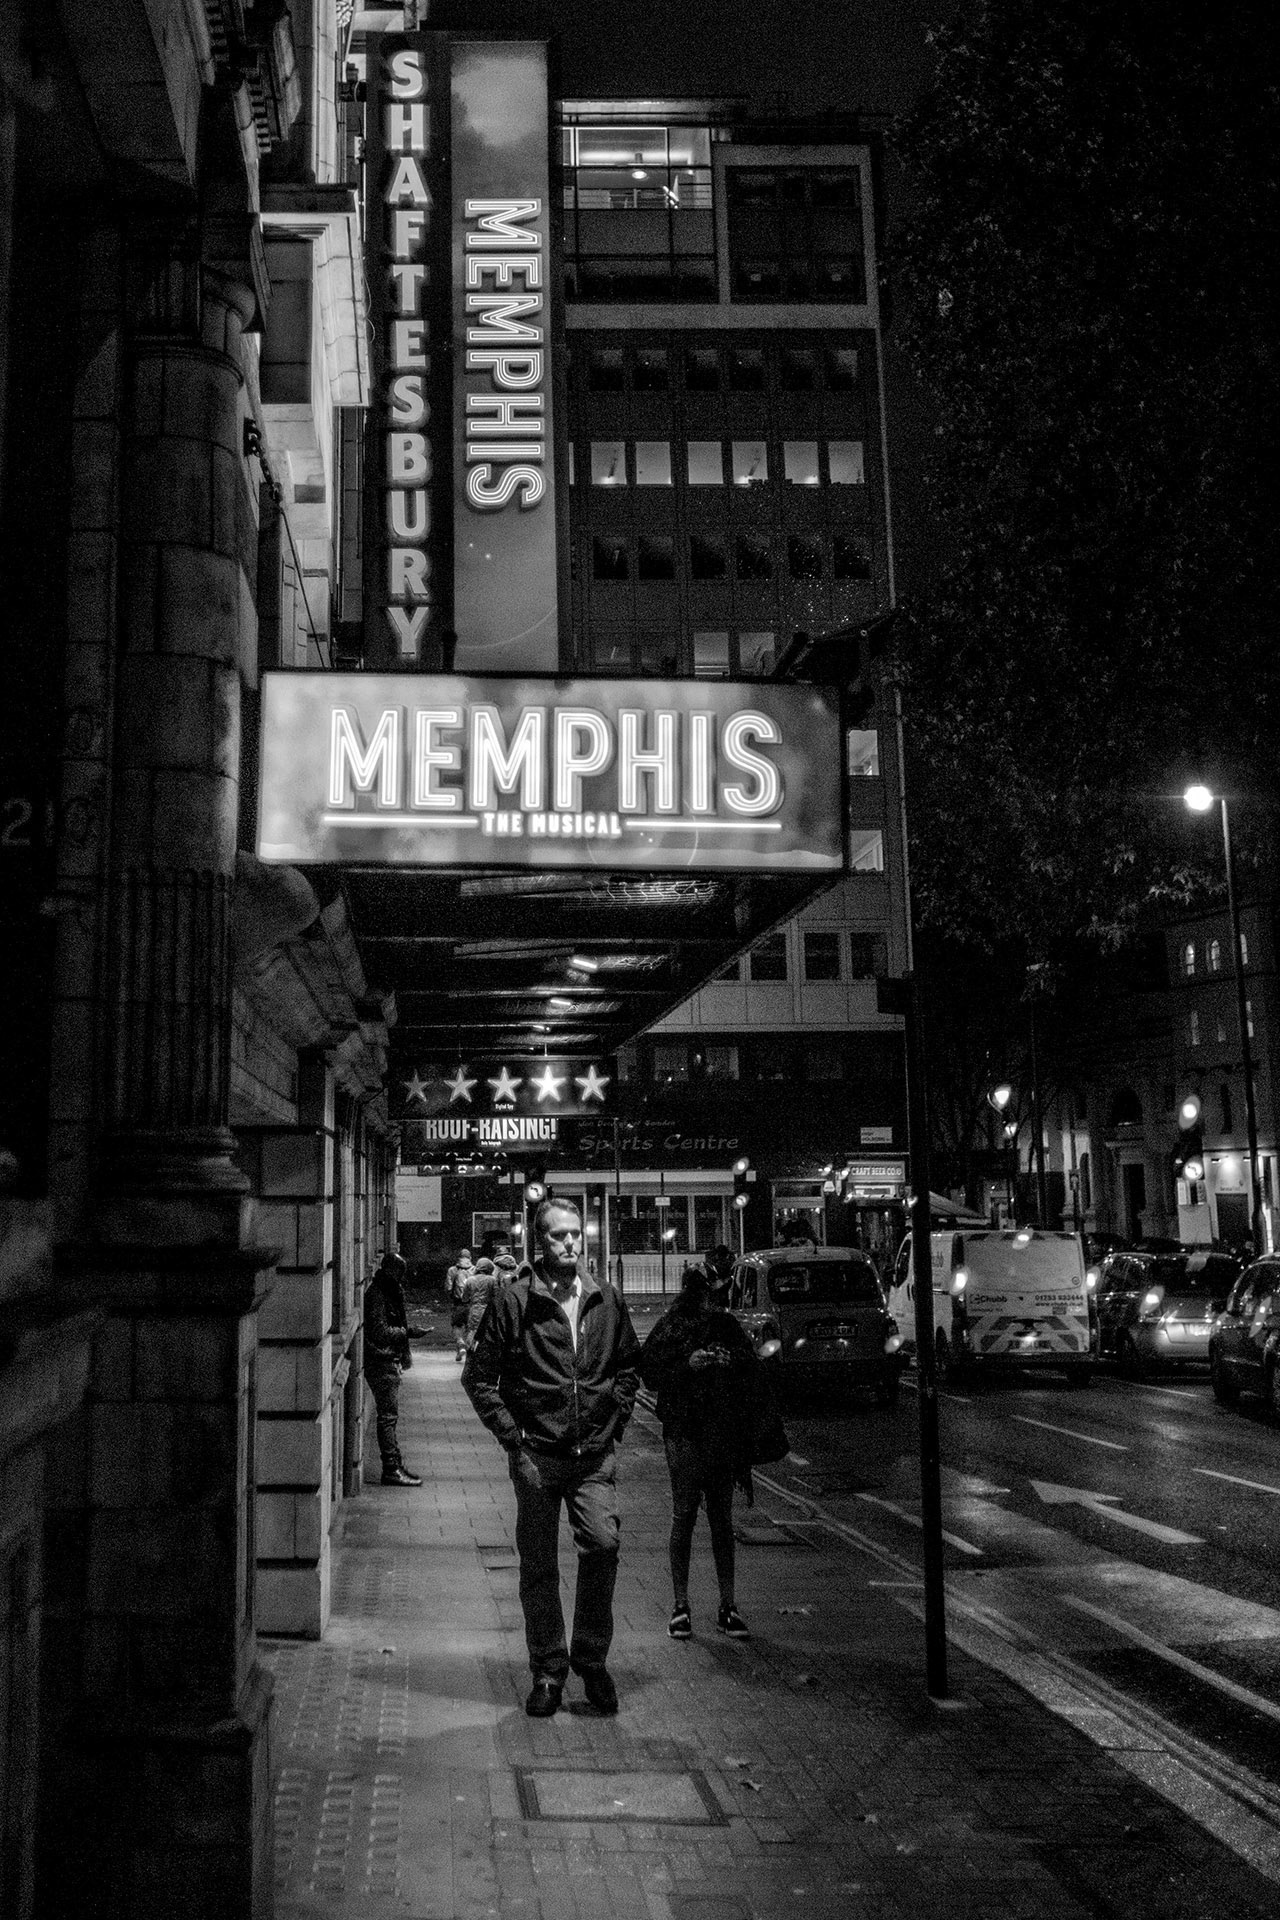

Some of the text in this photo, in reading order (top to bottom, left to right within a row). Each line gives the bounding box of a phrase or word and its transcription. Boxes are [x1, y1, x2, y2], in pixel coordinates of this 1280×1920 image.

[387, 50, 433, 660] SHAFTESBURY
[464, 197, 546, 510] MEMPHIS
[327, 704, 784, 818] MEMPHIS
[480, 811, 624, 839] THE MUSICAL
[578, 1133, 739, 1154] Sports Centre
[851, 1166, 870, 1176] CRAFT
[871, 1166, 886, 1176] BEER
[980, 1295, 1008, 1303] Chubb
